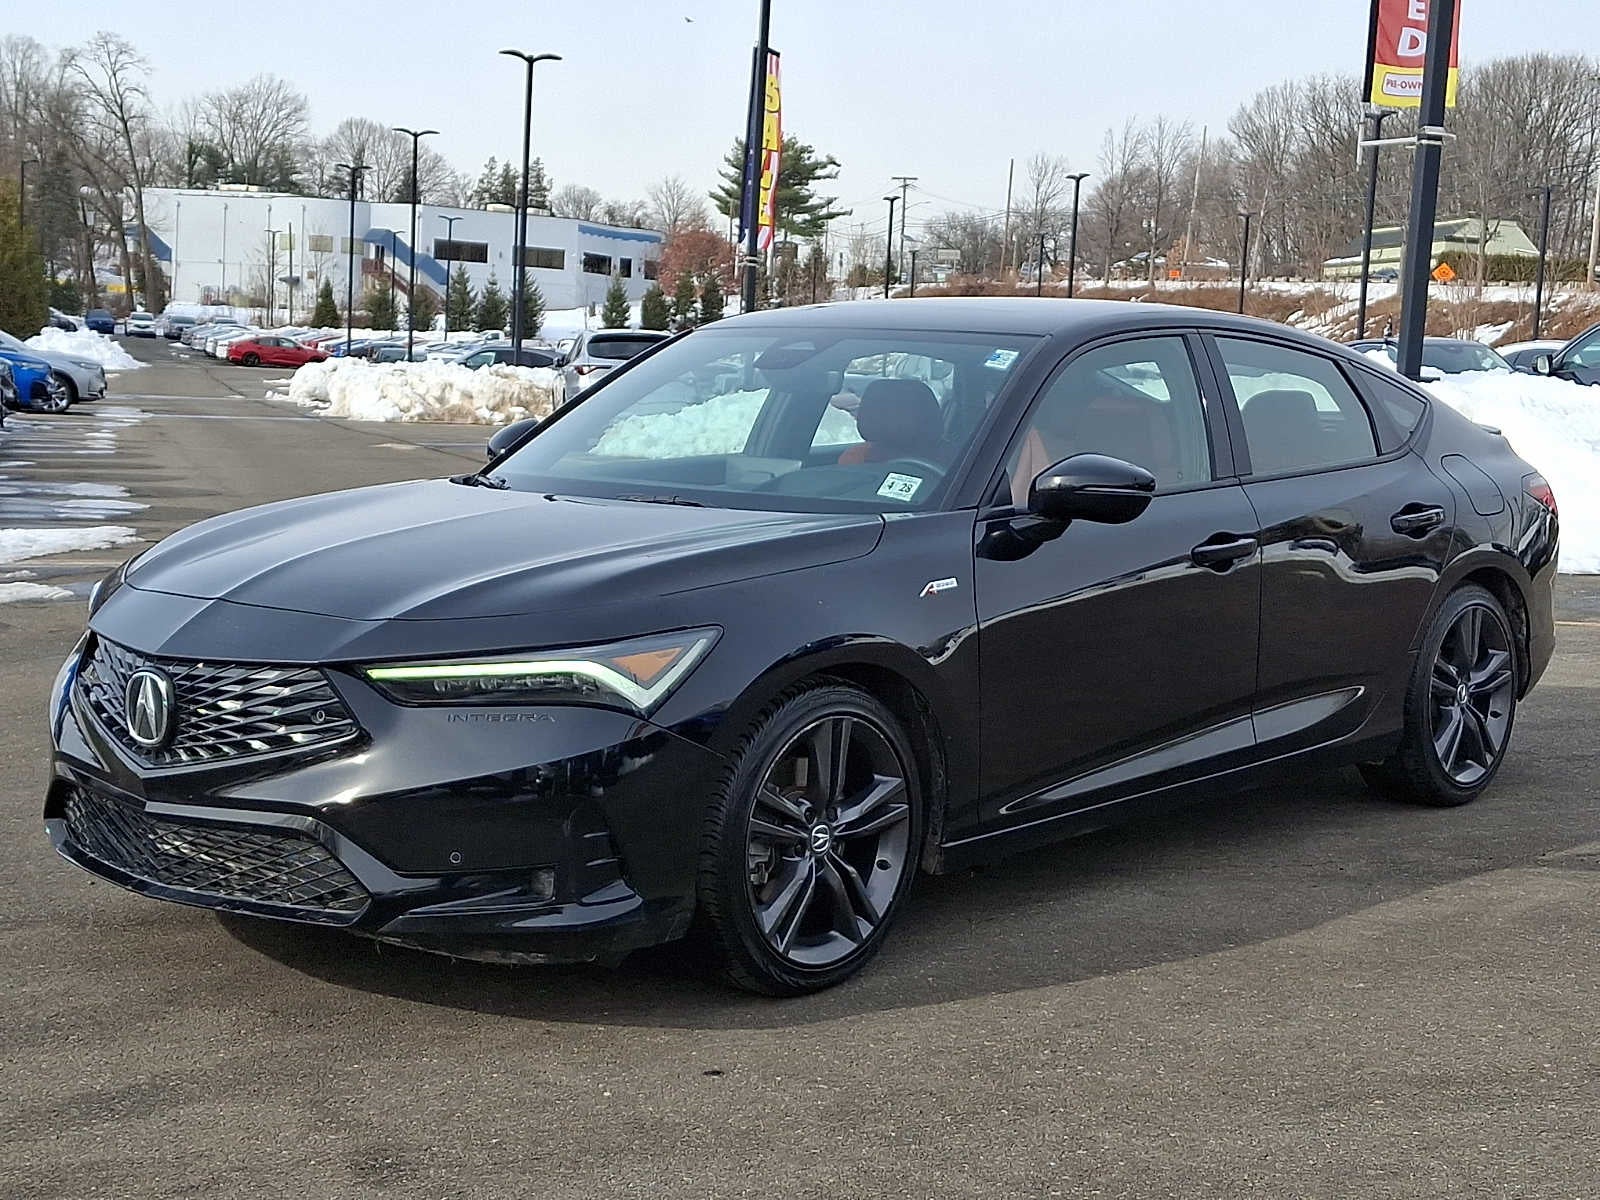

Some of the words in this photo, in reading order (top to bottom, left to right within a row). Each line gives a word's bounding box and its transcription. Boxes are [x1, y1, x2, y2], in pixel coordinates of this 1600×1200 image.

[1397, 0, 1427, 57] ED
[1386, 79, 1423, 89] PRE-OWN
[898, 482, 914, 493] 28
[447, 712, 555, 723] INTEGRA
